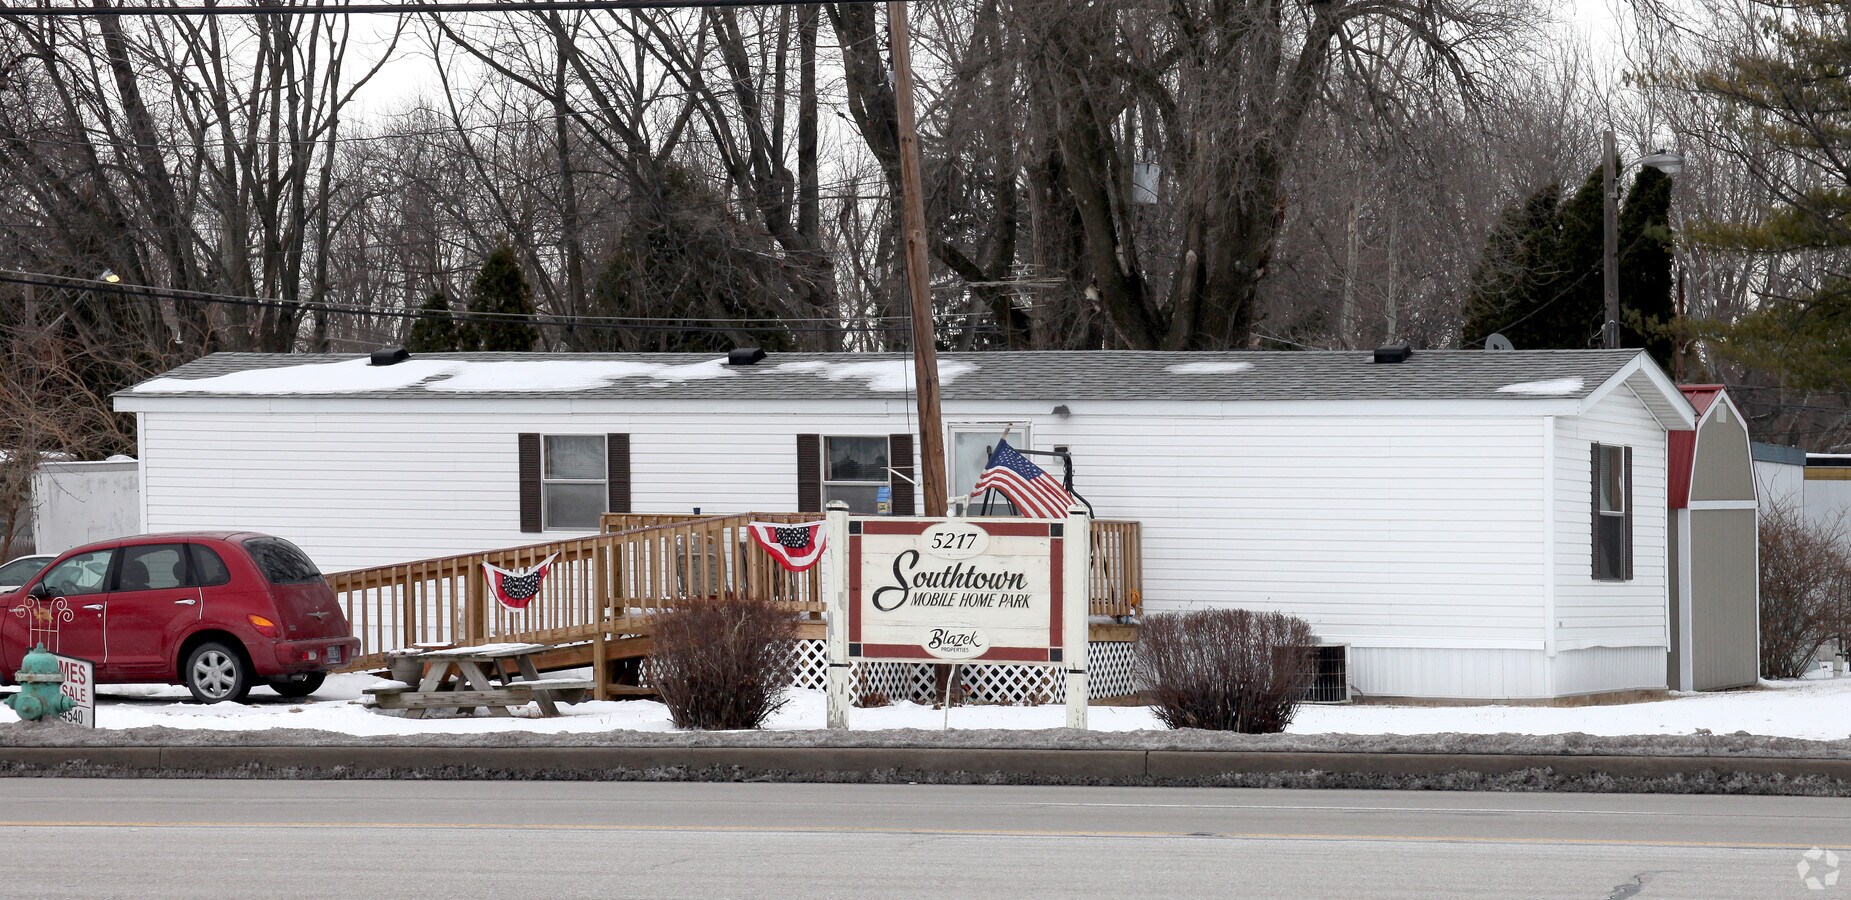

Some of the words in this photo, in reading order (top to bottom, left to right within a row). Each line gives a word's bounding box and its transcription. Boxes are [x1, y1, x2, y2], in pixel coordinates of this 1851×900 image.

[931, 533, 978, 549] 5217
[872, 549, 1028, 612] Southtown
[910, 592, 956, 607] MOBILE
[959, 592, 994, 608] HOME
[999, 593, 1032, 609] PARK
[928, 628, 982, 650] Blazek
[62, 684, 86, 703] SALE
